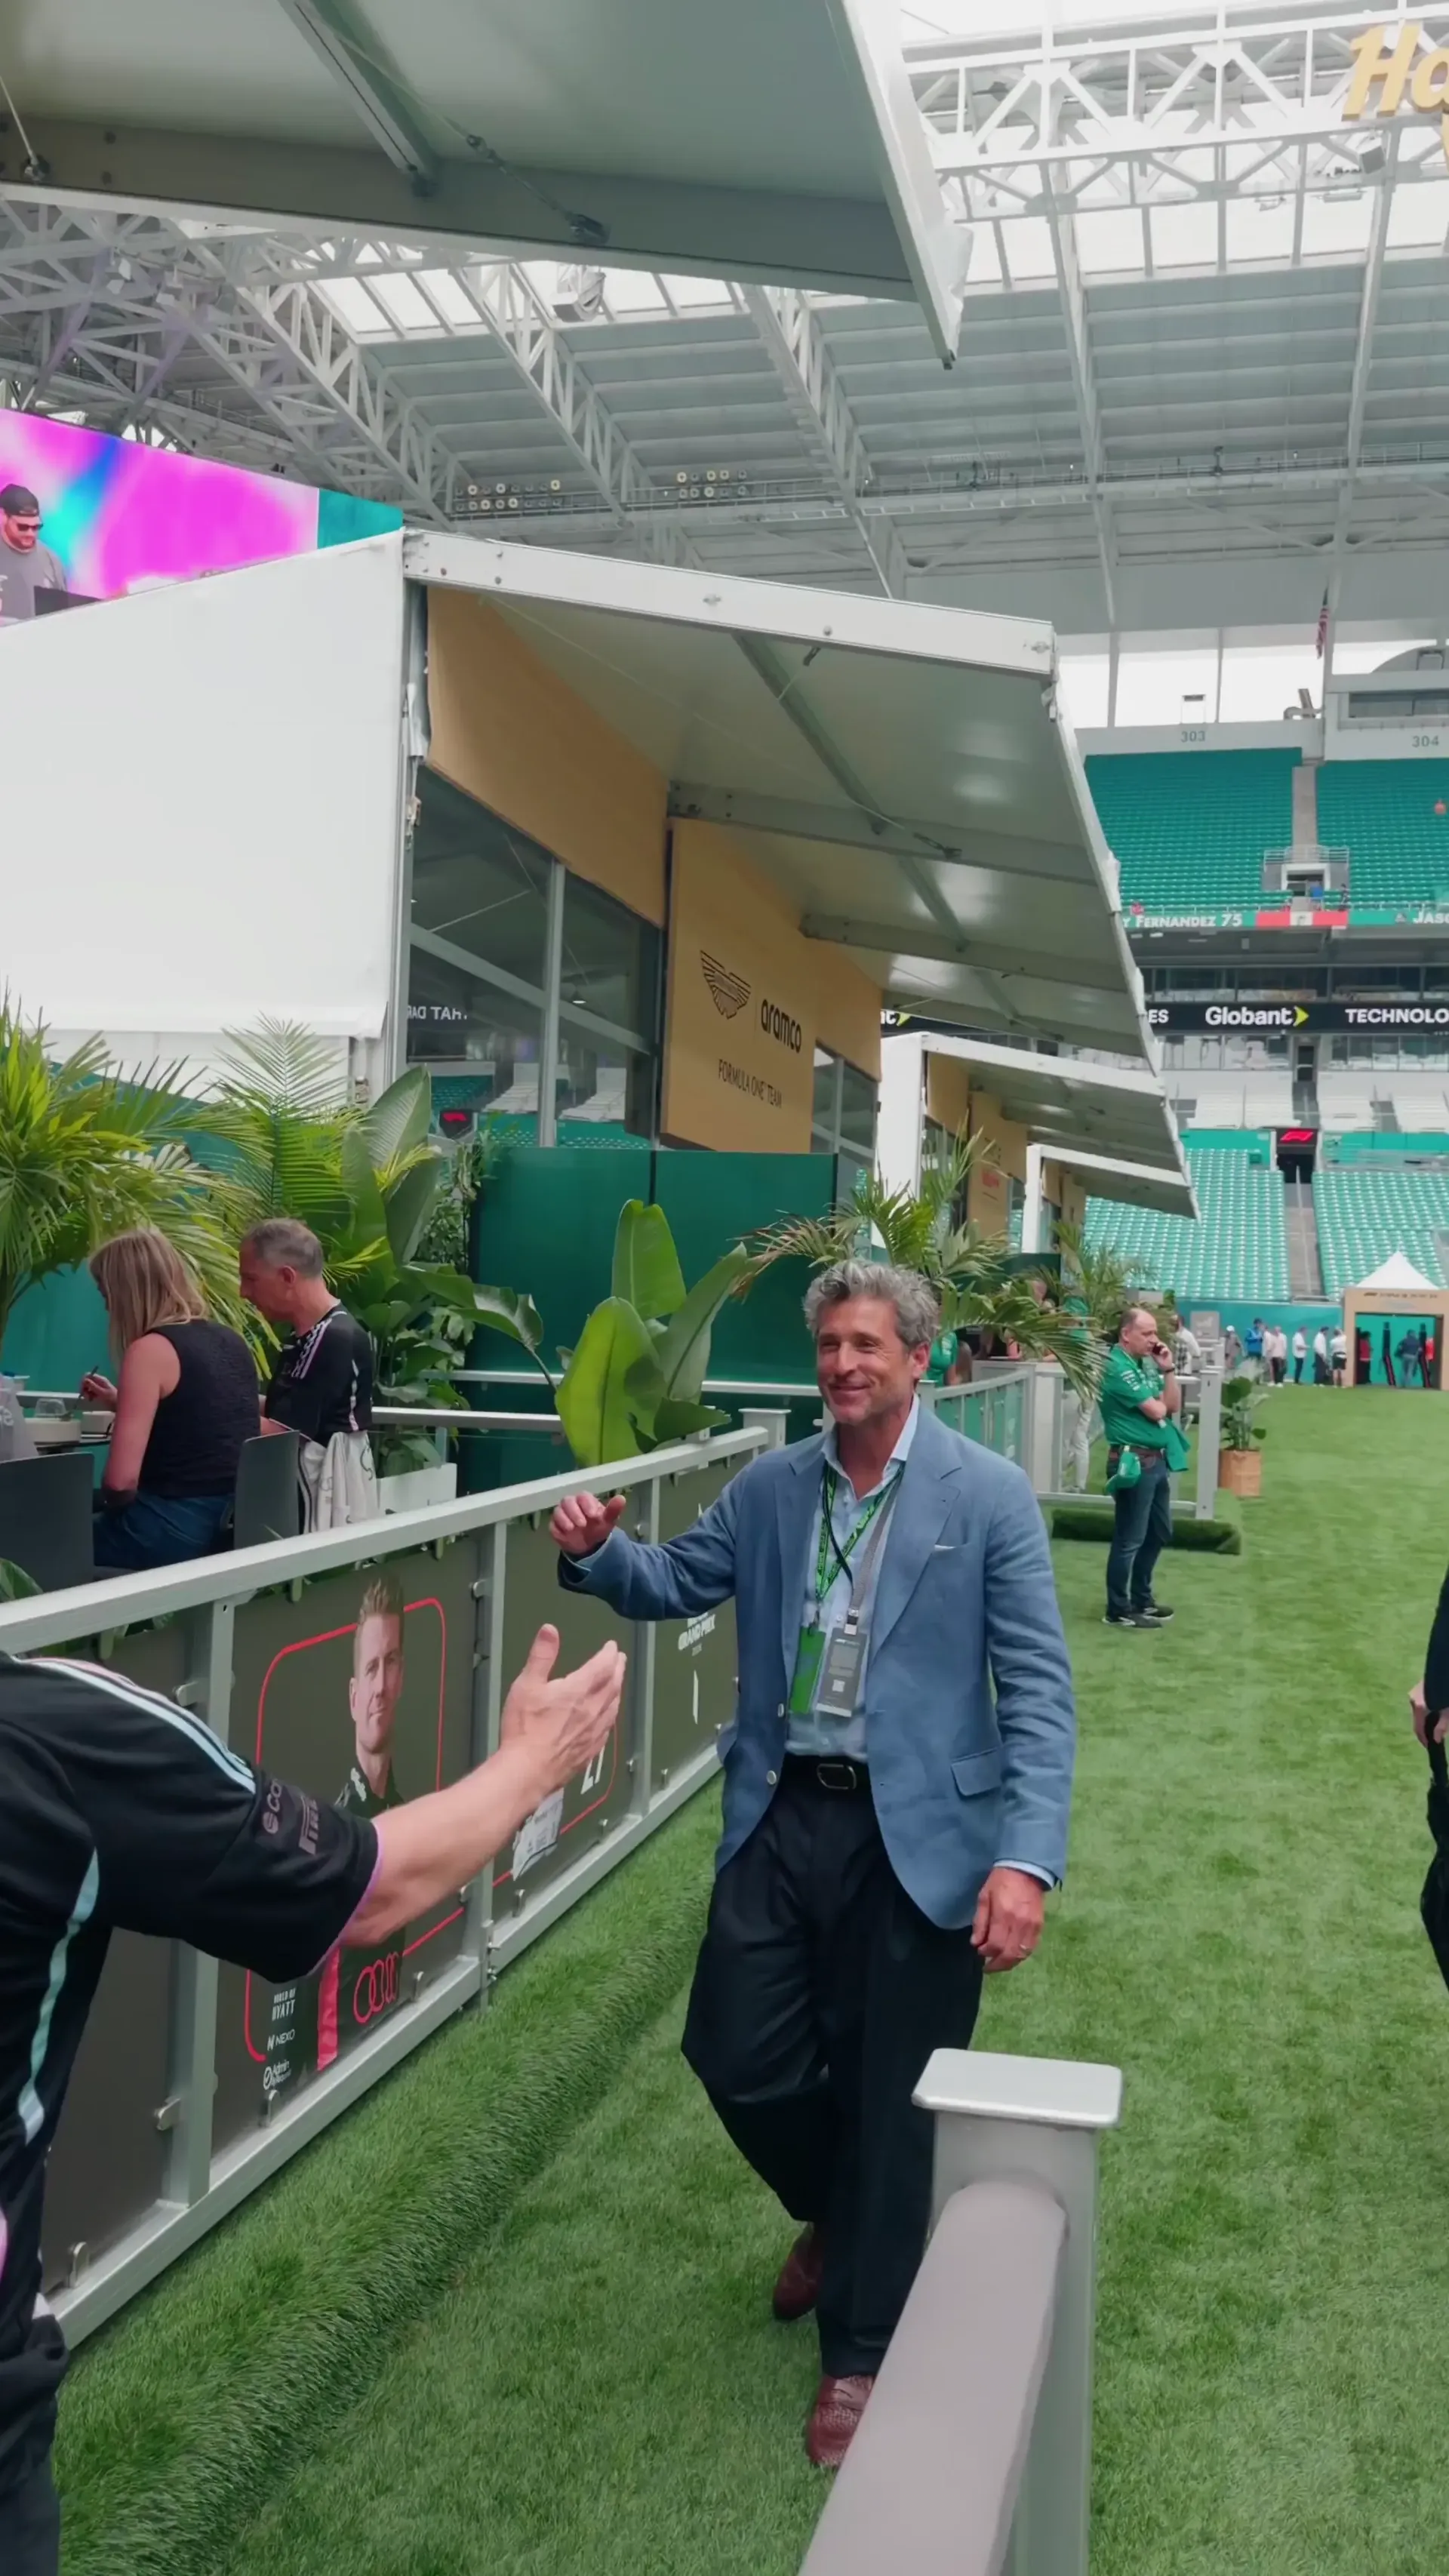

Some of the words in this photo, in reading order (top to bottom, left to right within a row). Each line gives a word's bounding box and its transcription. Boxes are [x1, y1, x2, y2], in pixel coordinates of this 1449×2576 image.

[1180, 731, 1205, 742] 303
[1411, 735, 1439, 747] 304
[1221, 913, 1242, 927] 75
[1148, 1009, 1169, 1023] ES
[1205, 1006, 1293, 1025] Globant
[761, 999, 801, 1054] aramco
[718, 1058, 749, 1094] FORMULA
[767, 1084, 782, 1108] TEAM
[272, 1999, 295, 2021] HYATT
[275, 2029, 295, 2045] NEXO
